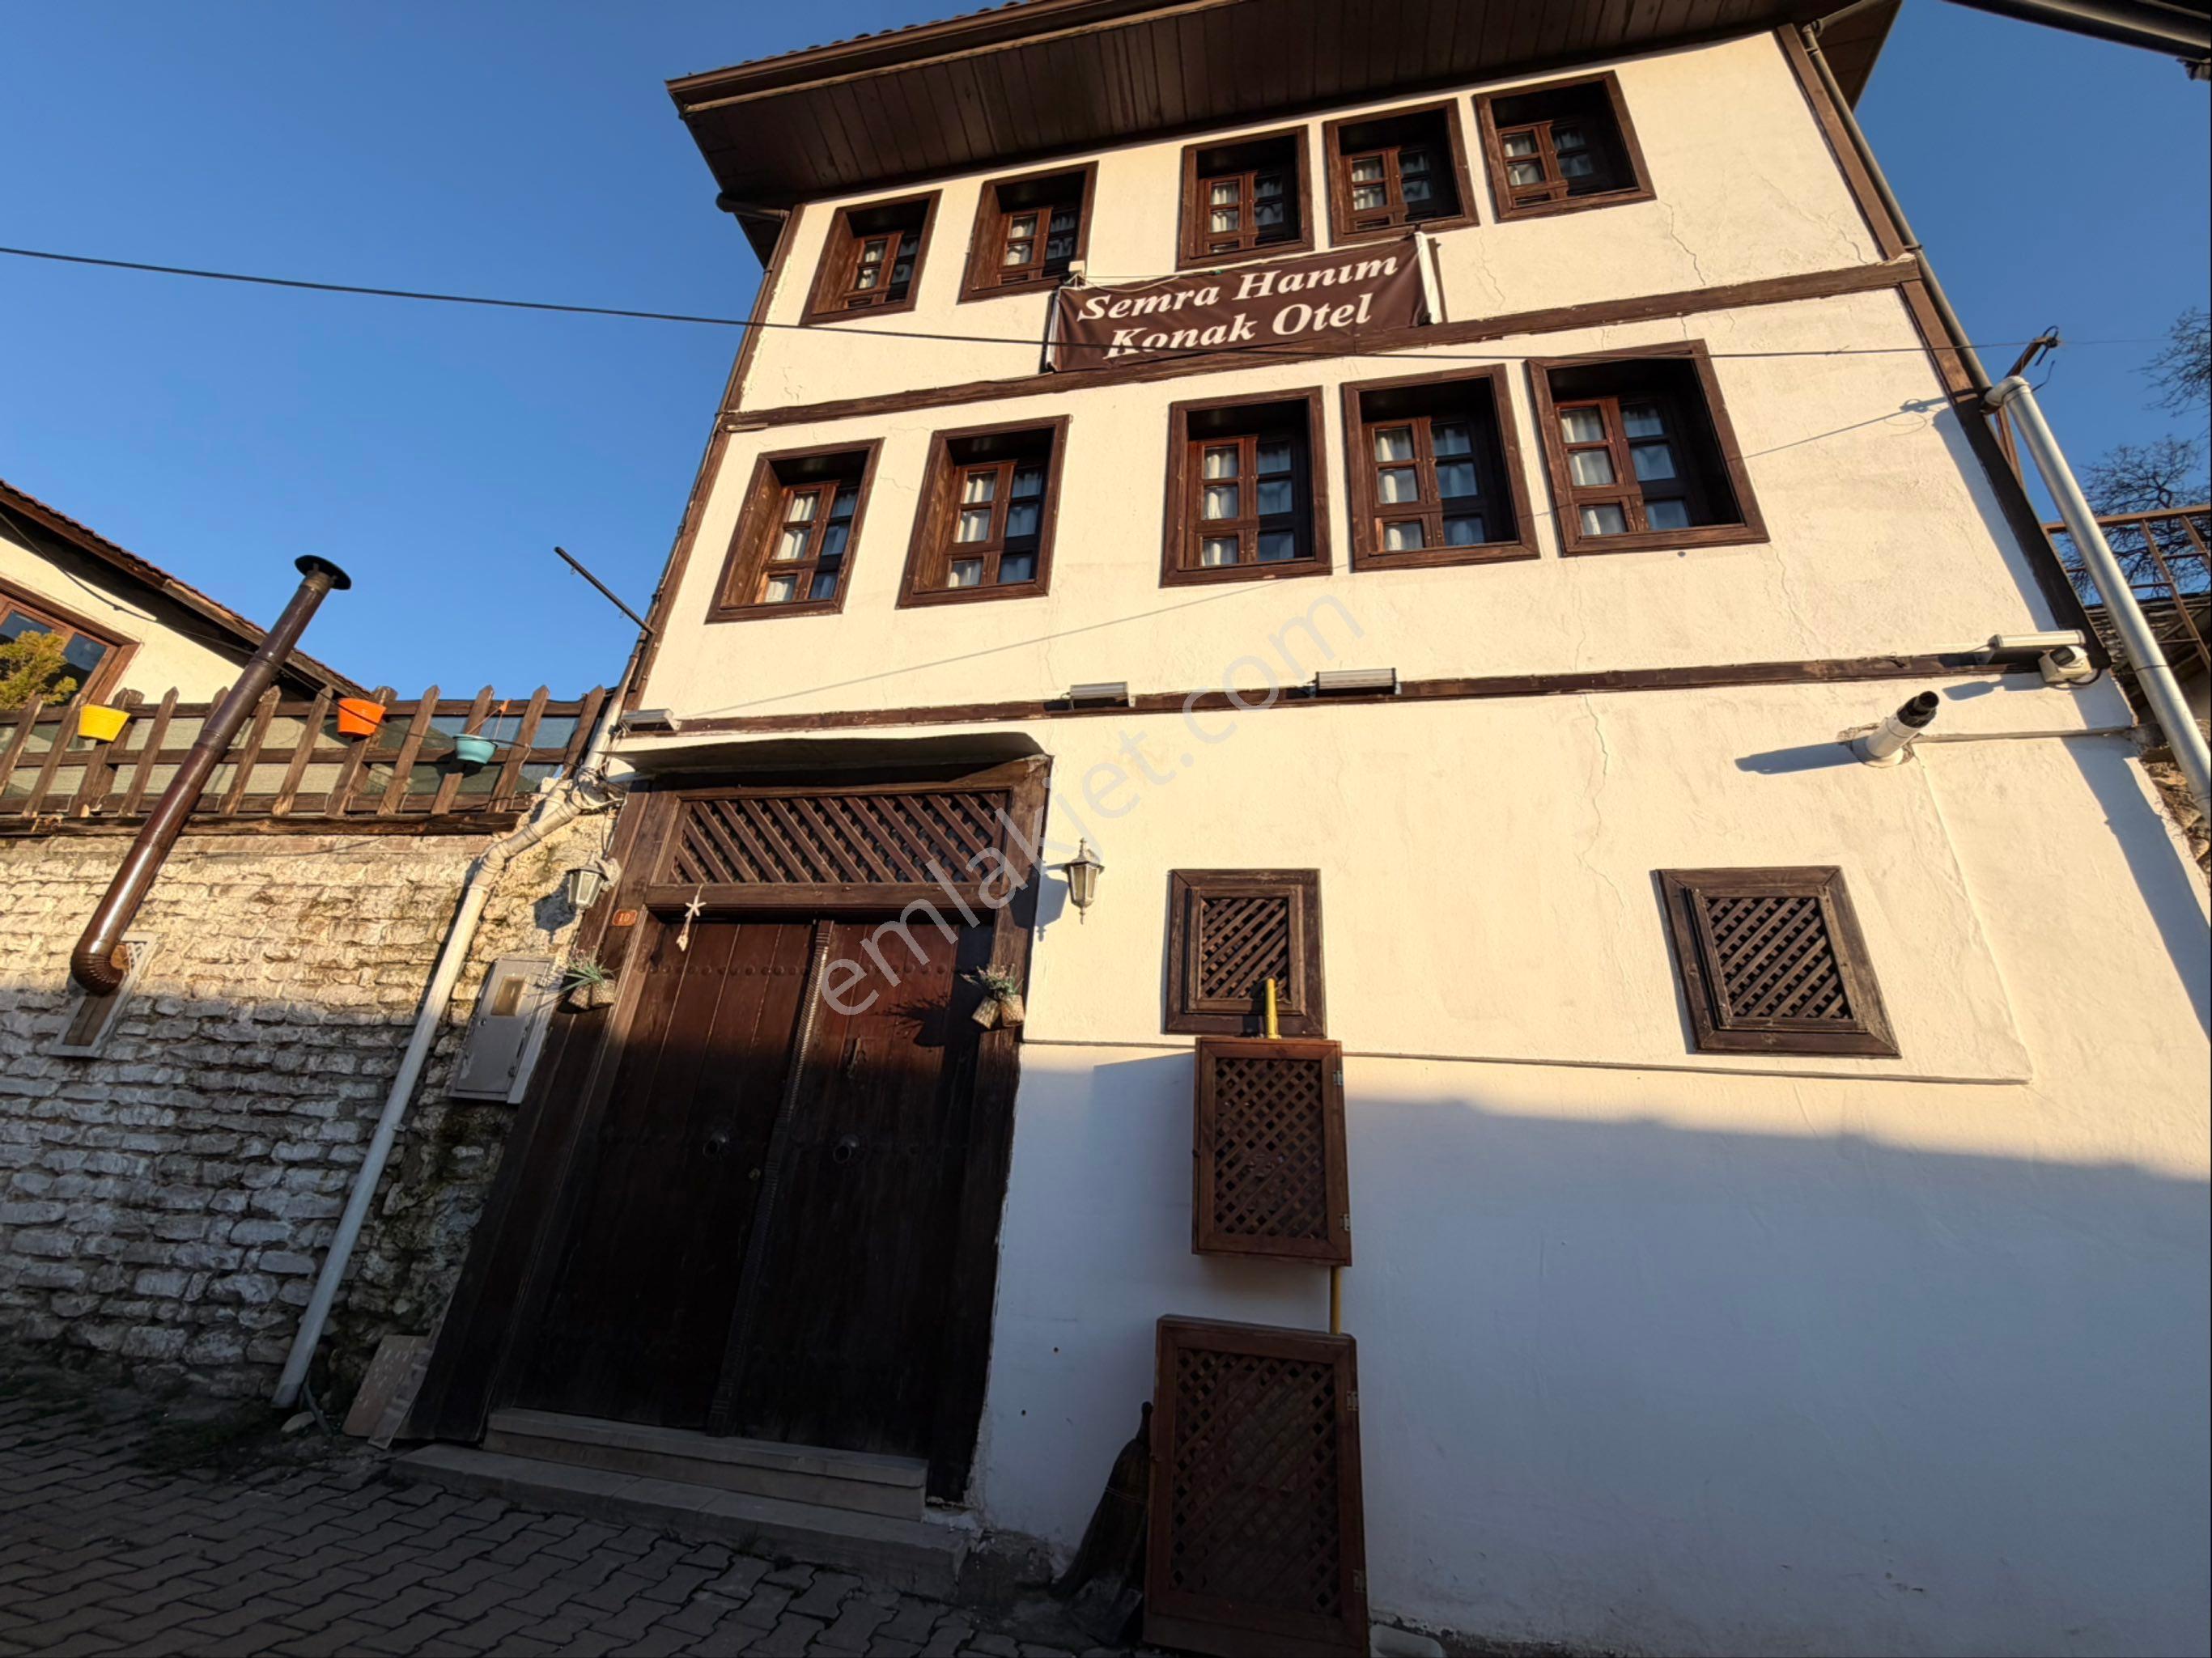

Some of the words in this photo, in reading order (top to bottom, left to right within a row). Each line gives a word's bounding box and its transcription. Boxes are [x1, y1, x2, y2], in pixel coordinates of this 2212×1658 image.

[1077, 286, 1221, 322] Semra
[1231, 257, 1399, 300] Hanım
[1102, 313, 1258, 359] Konak
[1272, 292, 1373, 335] Otel
